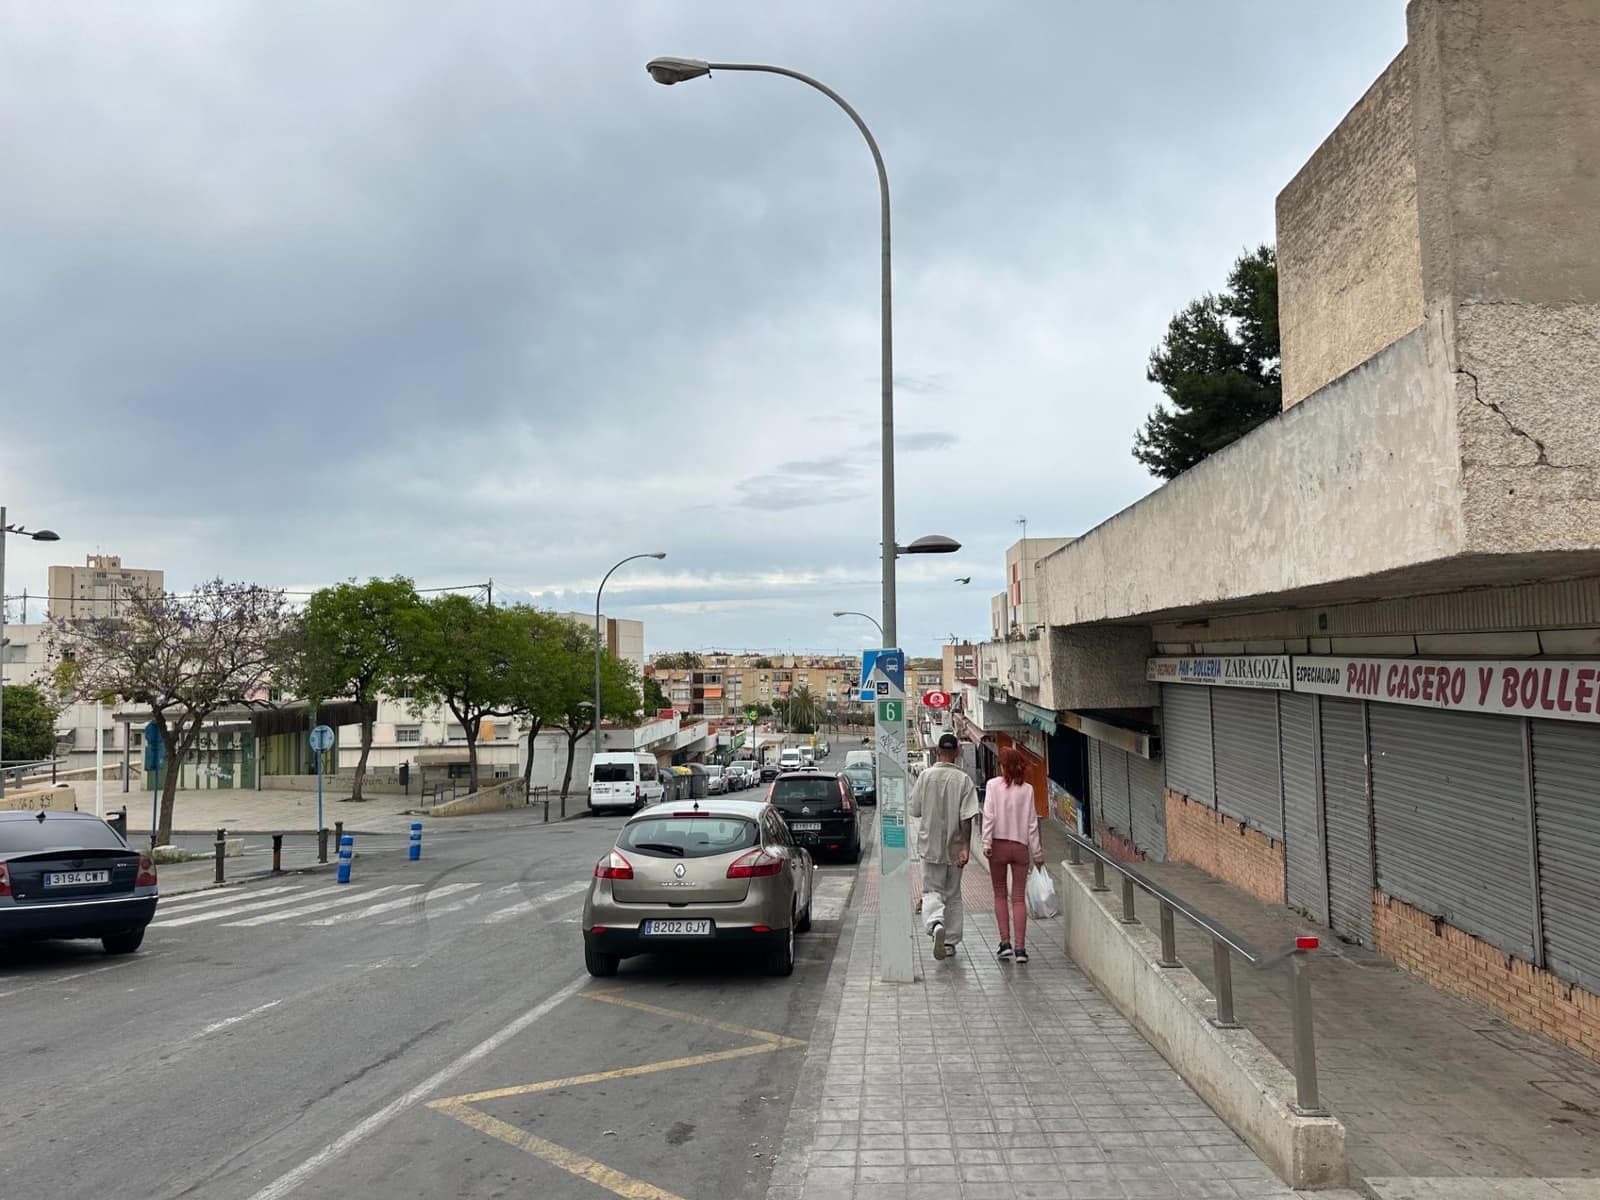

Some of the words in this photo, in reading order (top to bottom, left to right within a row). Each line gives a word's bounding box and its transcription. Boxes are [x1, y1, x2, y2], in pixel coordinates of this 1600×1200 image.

[1179, 659, 1189, 676] PAN
[1224, 658, 1289, 680] ZARAGOZA
[1296, 666, 1340, 685] ESPECIALIDAD
[1346, 662, 1381, 696] PAN
[1386, 664, 1466, 707] CASERO
[1478, 667, 1493, 706] Y
[1501, 667, 1600, 716] BOLLE
[886, 702, 896, 721] 6
[53, 873, 81, 884] 3194
[653, 922, 682, 933] 8202
[685, 922, 708, 933] GJY
